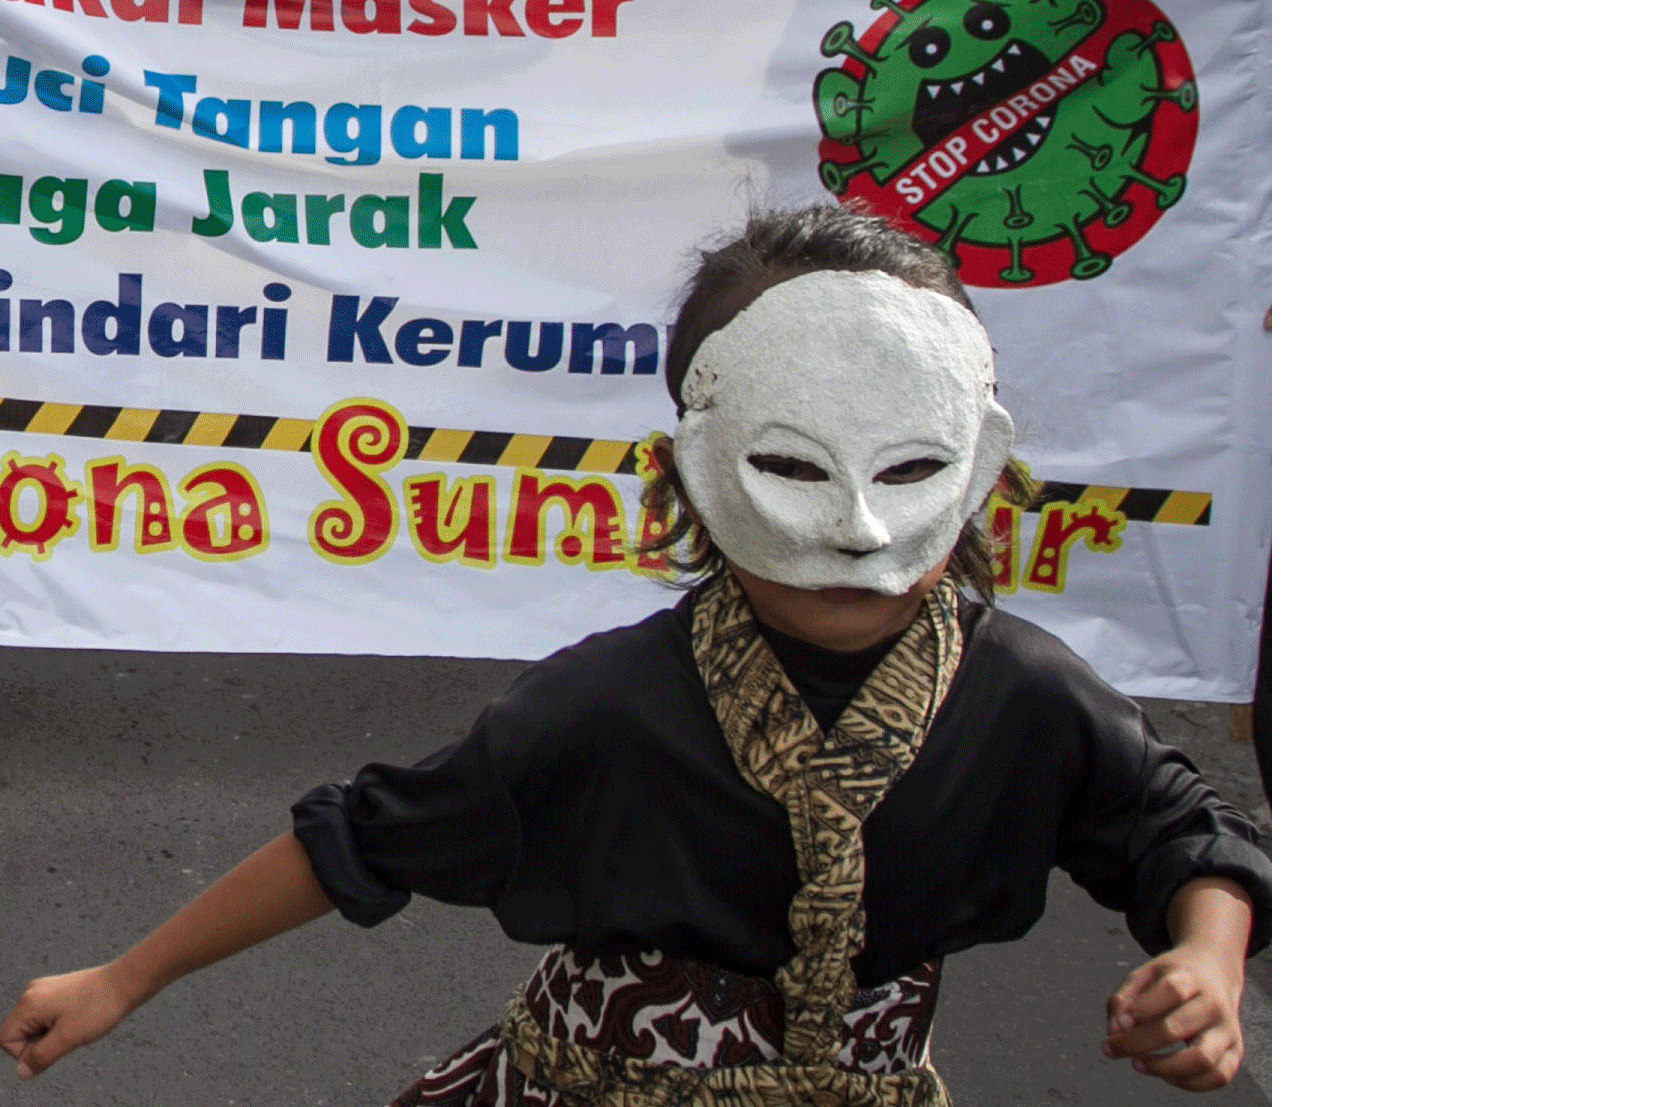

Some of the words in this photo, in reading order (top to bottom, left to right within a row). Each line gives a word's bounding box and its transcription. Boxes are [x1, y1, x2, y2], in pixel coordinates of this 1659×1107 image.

[144, 70, 519, 166] Tangan
[896, 136, 968, 204] STOP
[972, 55, 1097, 144] CORONA
[193, 170, 477, 249] Jarak
[327, 294, 672, 375] Kerum
